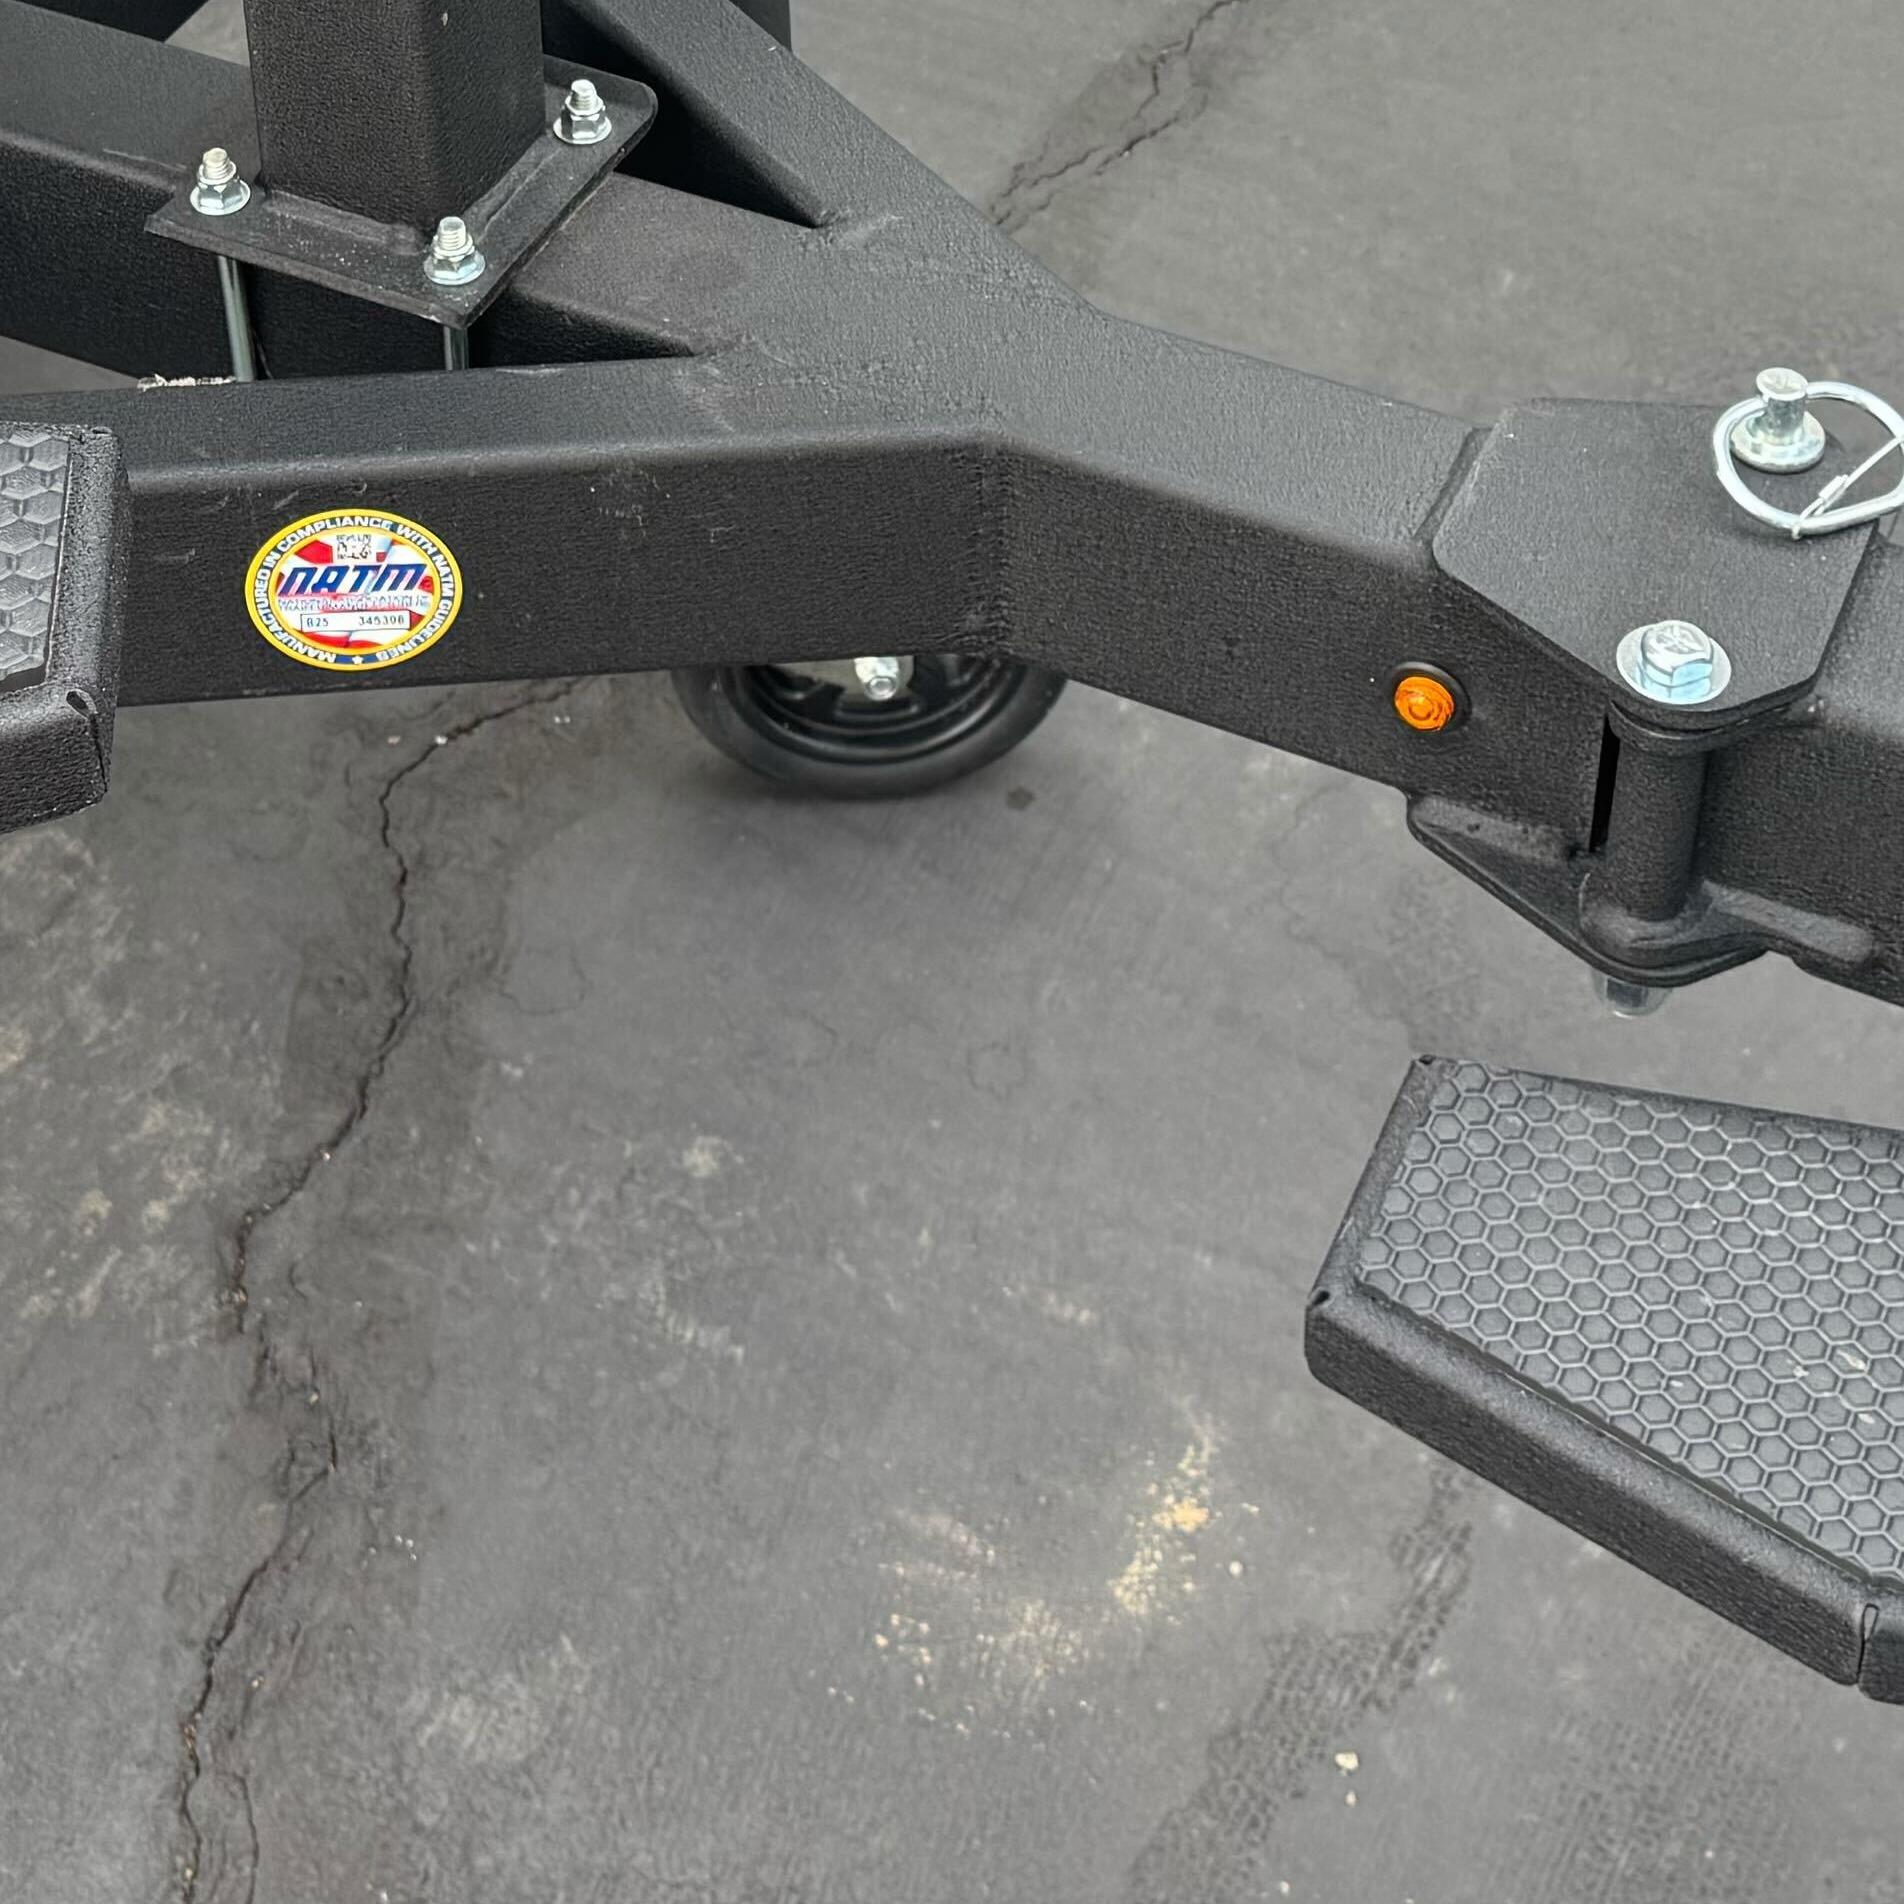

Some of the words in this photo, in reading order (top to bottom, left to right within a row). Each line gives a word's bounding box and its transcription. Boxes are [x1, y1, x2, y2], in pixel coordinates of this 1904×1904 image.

[277, 516, 393, 551] COMPLIANCE
[397, 524, 436, 554] WITH
[264, 552, 277, 567] IN
[434, 554, 455, 597] NATM
[255, 571, 336, 662] MANUFACTURED
[376, 599, 454, 661] GUIDELINES
